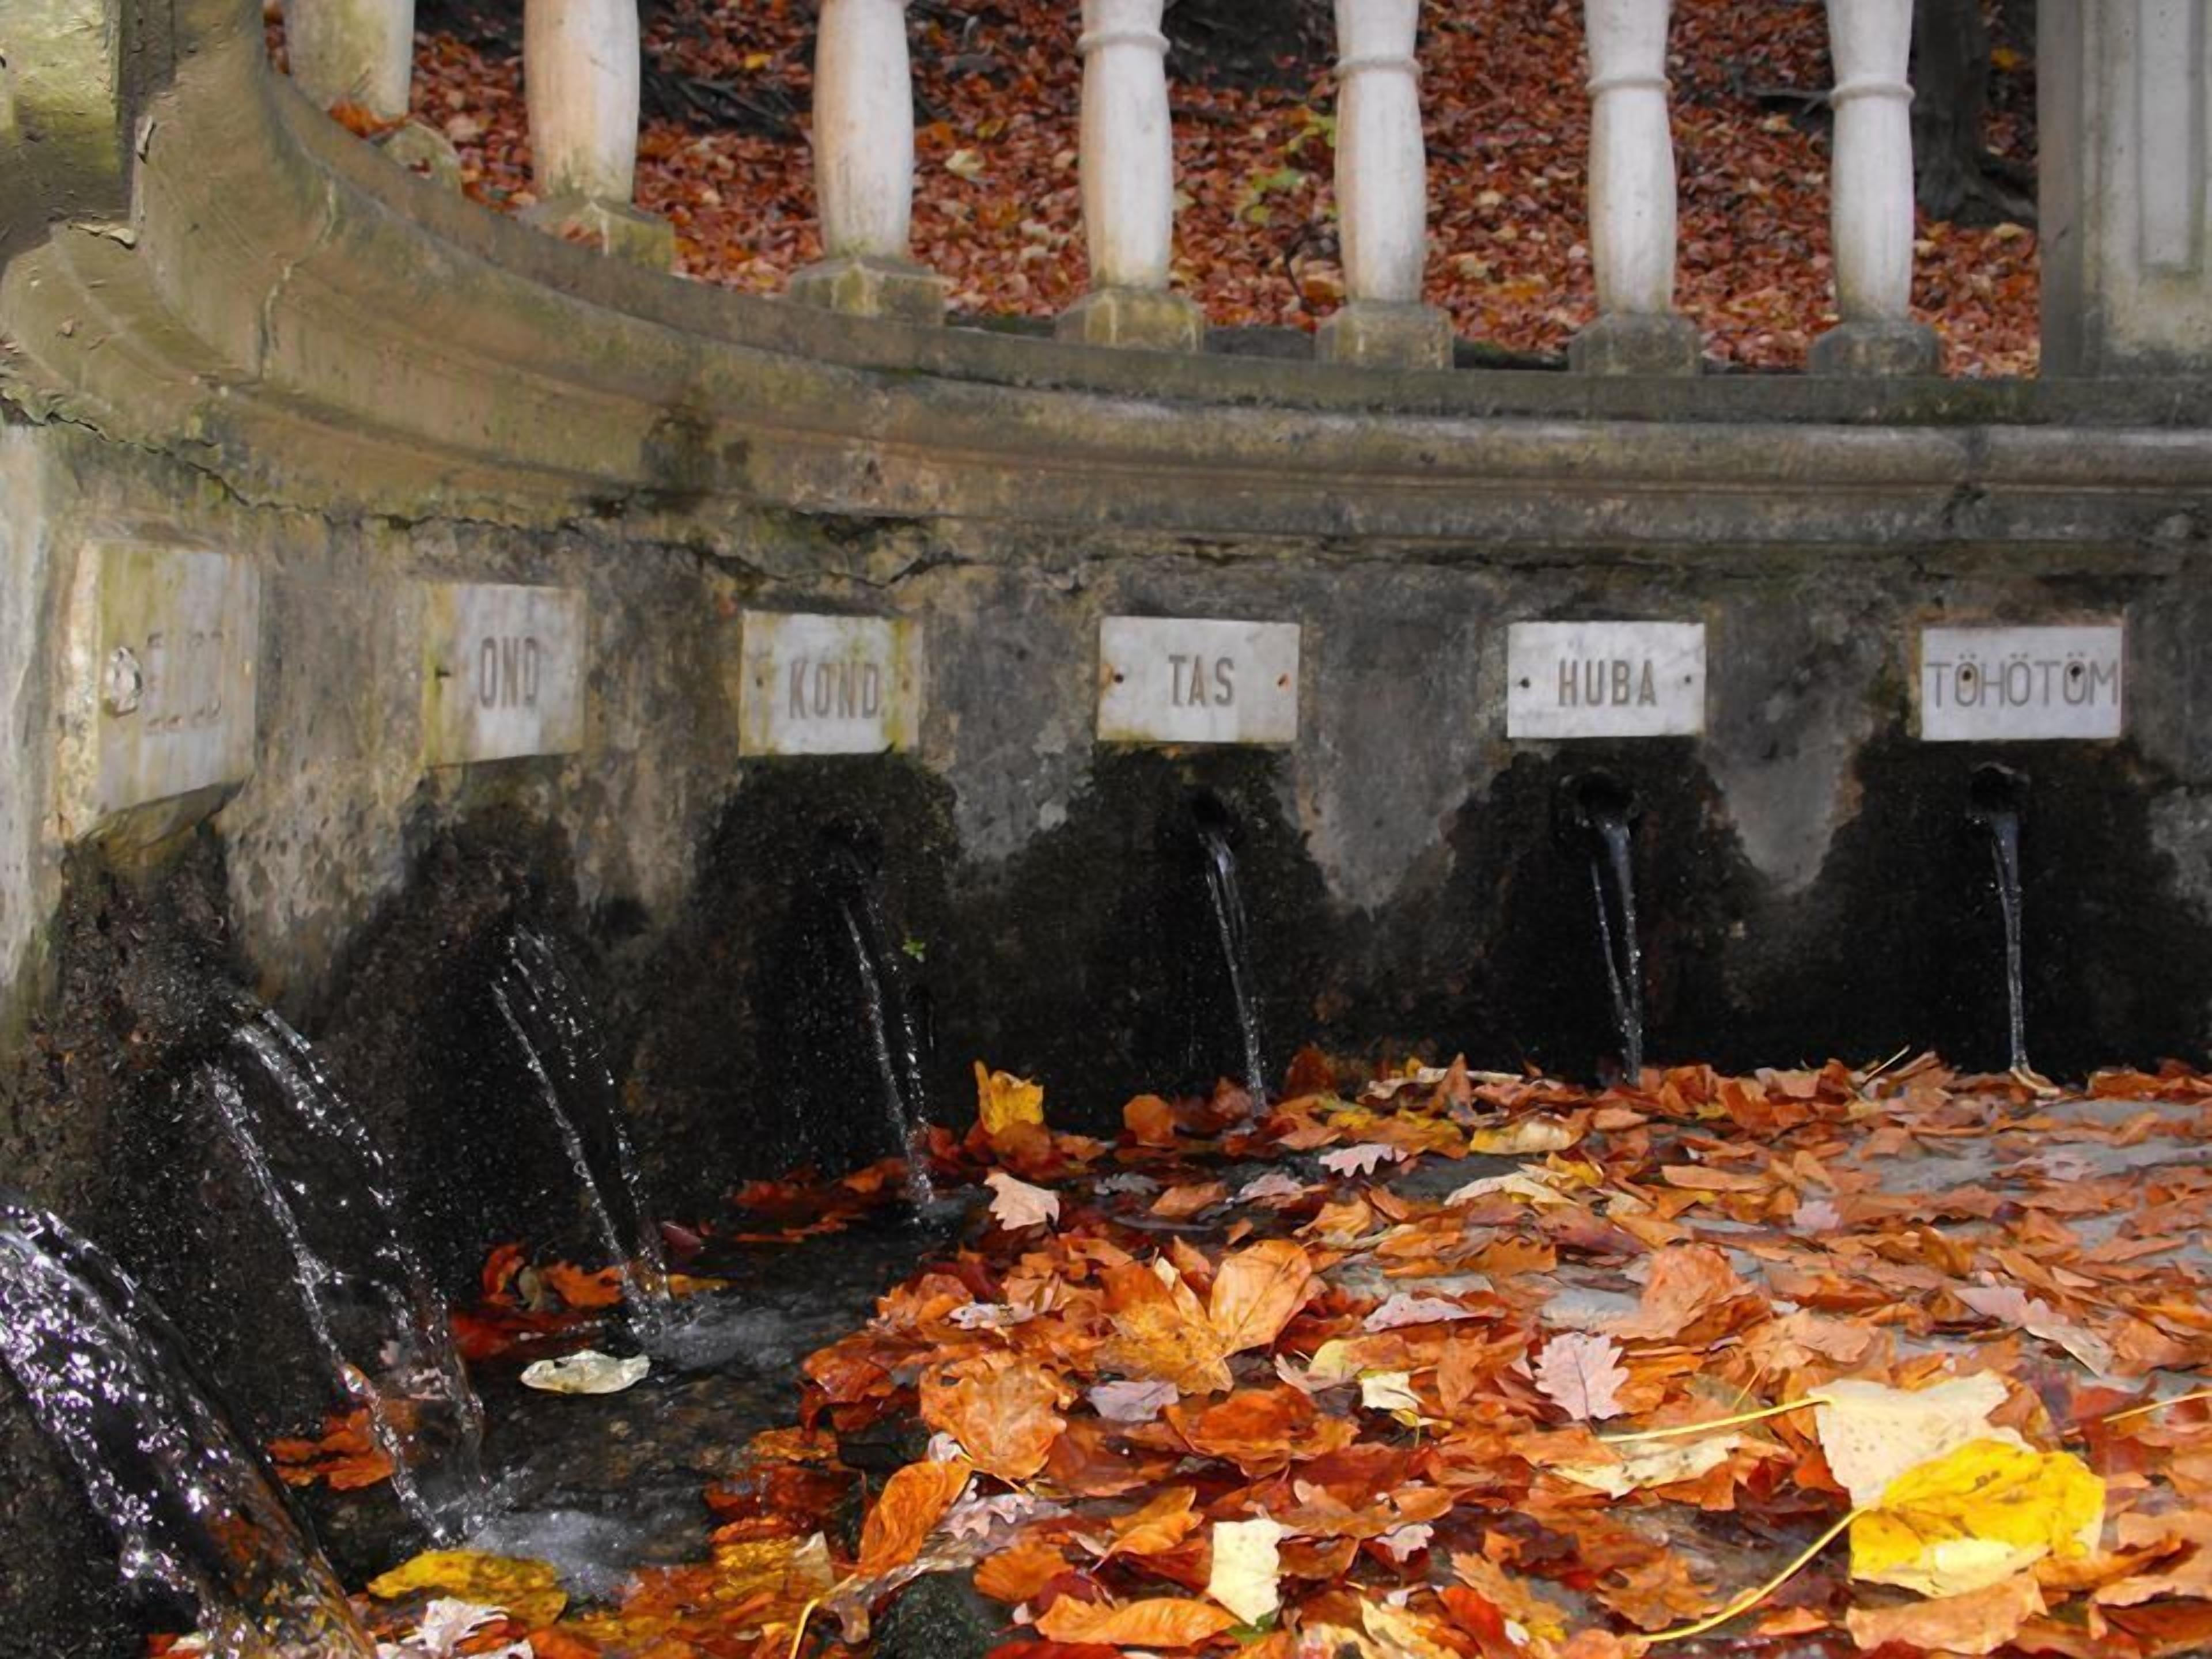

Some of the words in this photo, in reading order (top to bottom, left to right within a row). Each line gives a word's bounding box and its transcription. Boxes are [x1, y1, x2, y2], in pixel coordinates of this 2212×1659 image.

[480, 637, 539, 709] OND
[790, 657, 879, 719] KOND
[1168, 654, 1234, 707] TAS
[1558, 658, 1657, 707] HUBA
[1926, 652, 2119, 708] TÖHÖTÖM
